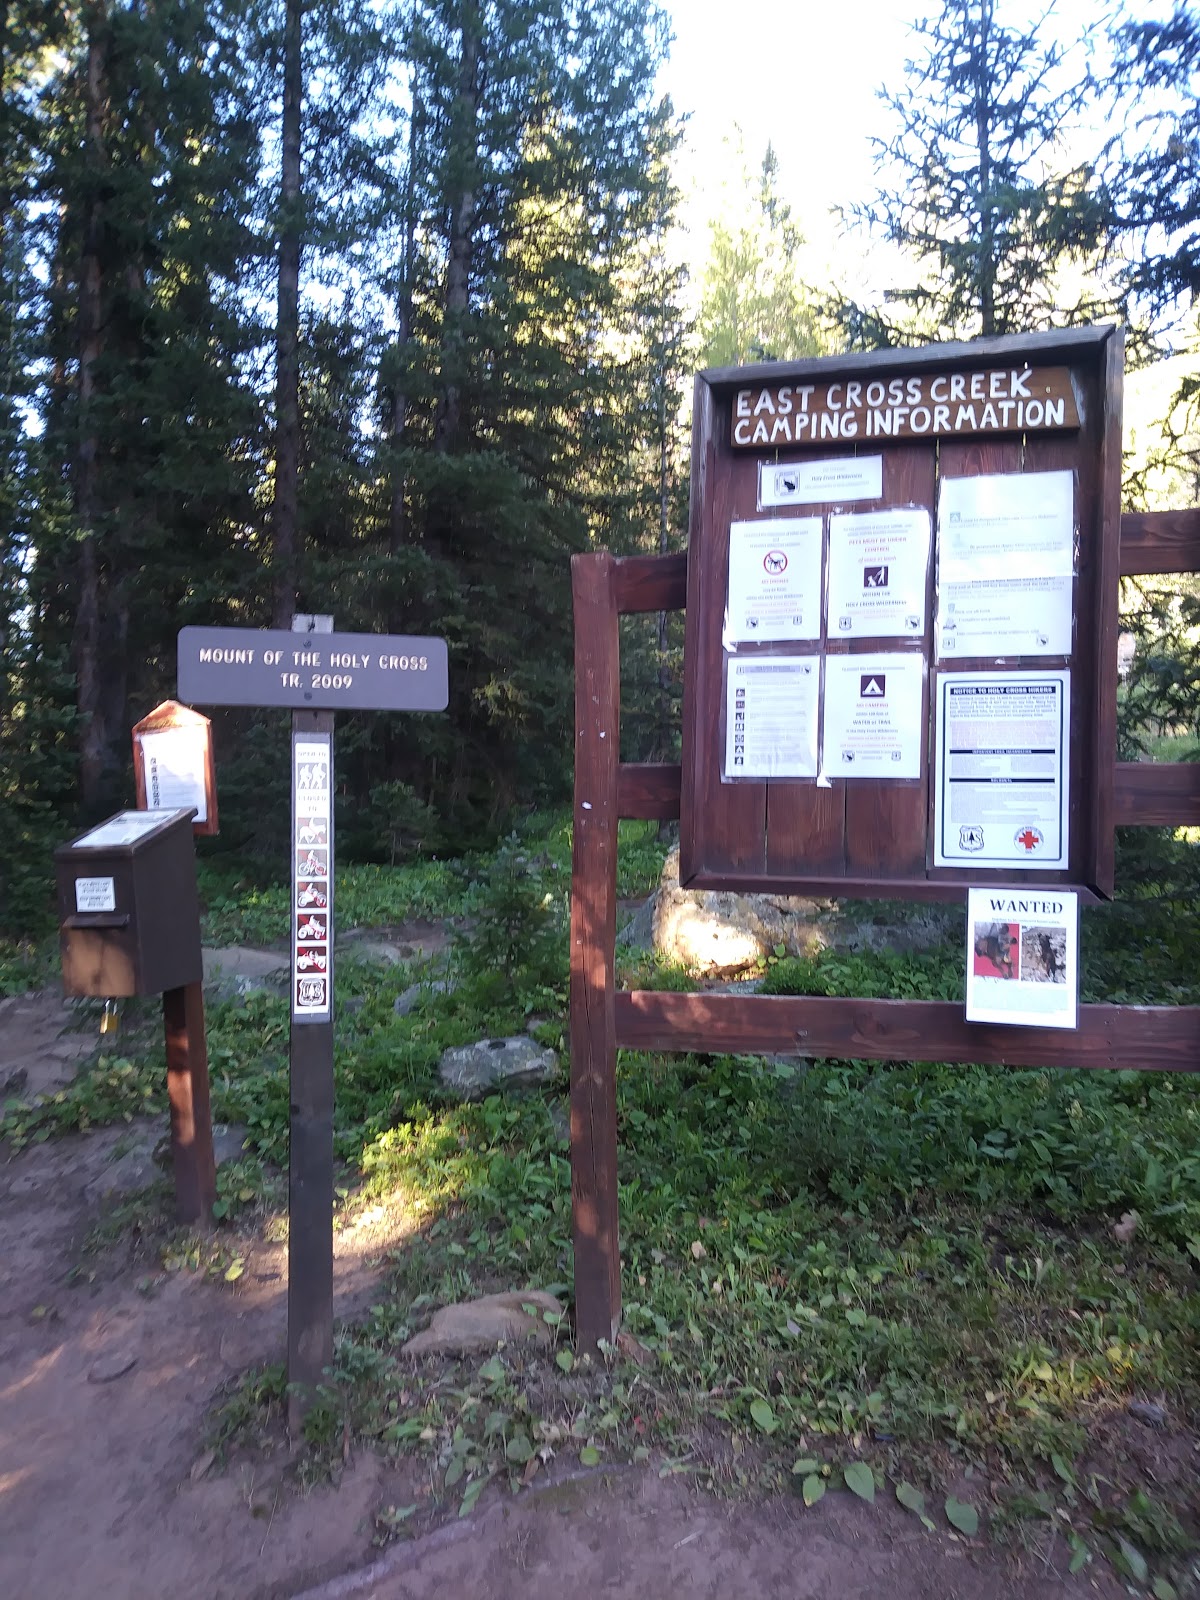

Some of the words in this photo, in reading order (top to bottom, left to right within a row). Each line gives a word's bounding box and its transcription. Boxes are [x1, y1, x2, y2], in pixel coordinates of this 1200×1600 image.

[737, 385, 815, 417] EAST
[826, 377, 922, 411] CROSS
[930, 369, 1033, 403] CREEK
[734, 411, 858, 445] CAMPING
[866, 398, 1065, 436] INFORMATION
[199, 648, 255, 665] MOUNT
[263, 650, 285, 666] OF
[292, 651, 321, 667] THE
[330, 653, 370, 669] HOLY
[379, 654, 428, 671] CROSS
[280, 672, 304, 688] TR.
[311, 673, 353, 690] 2009
[989, 898, 1063, 914] WANTED
